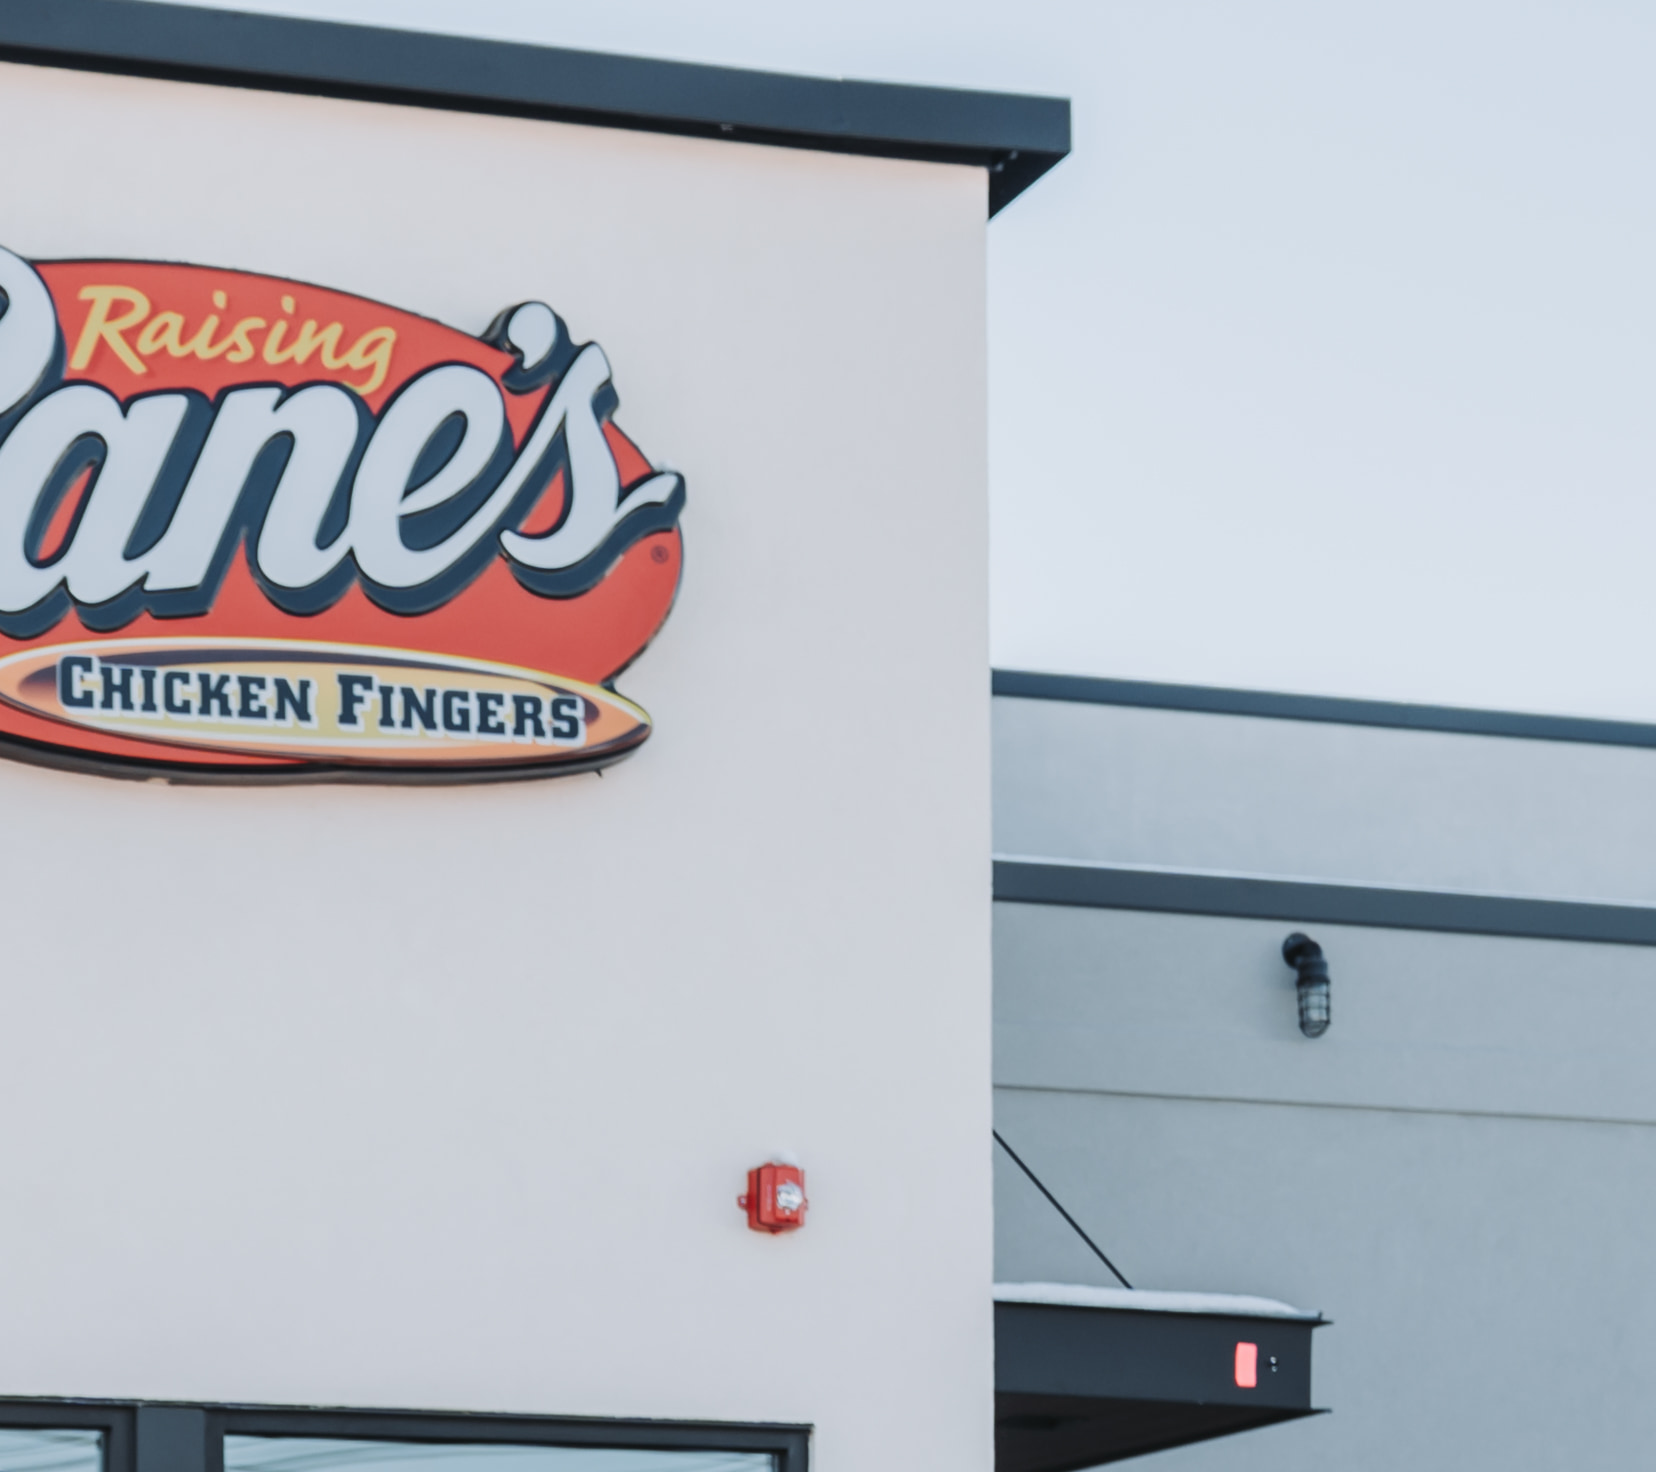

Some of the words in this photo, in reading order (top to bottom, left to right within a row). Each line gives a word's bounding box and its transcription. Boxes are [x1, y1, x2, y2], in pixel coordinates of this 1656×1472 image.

[69, 286, 396, 395] Raising
[58, 656, 313, 724] CHICKEN
[336, 674, 584, 741] FINGERS
